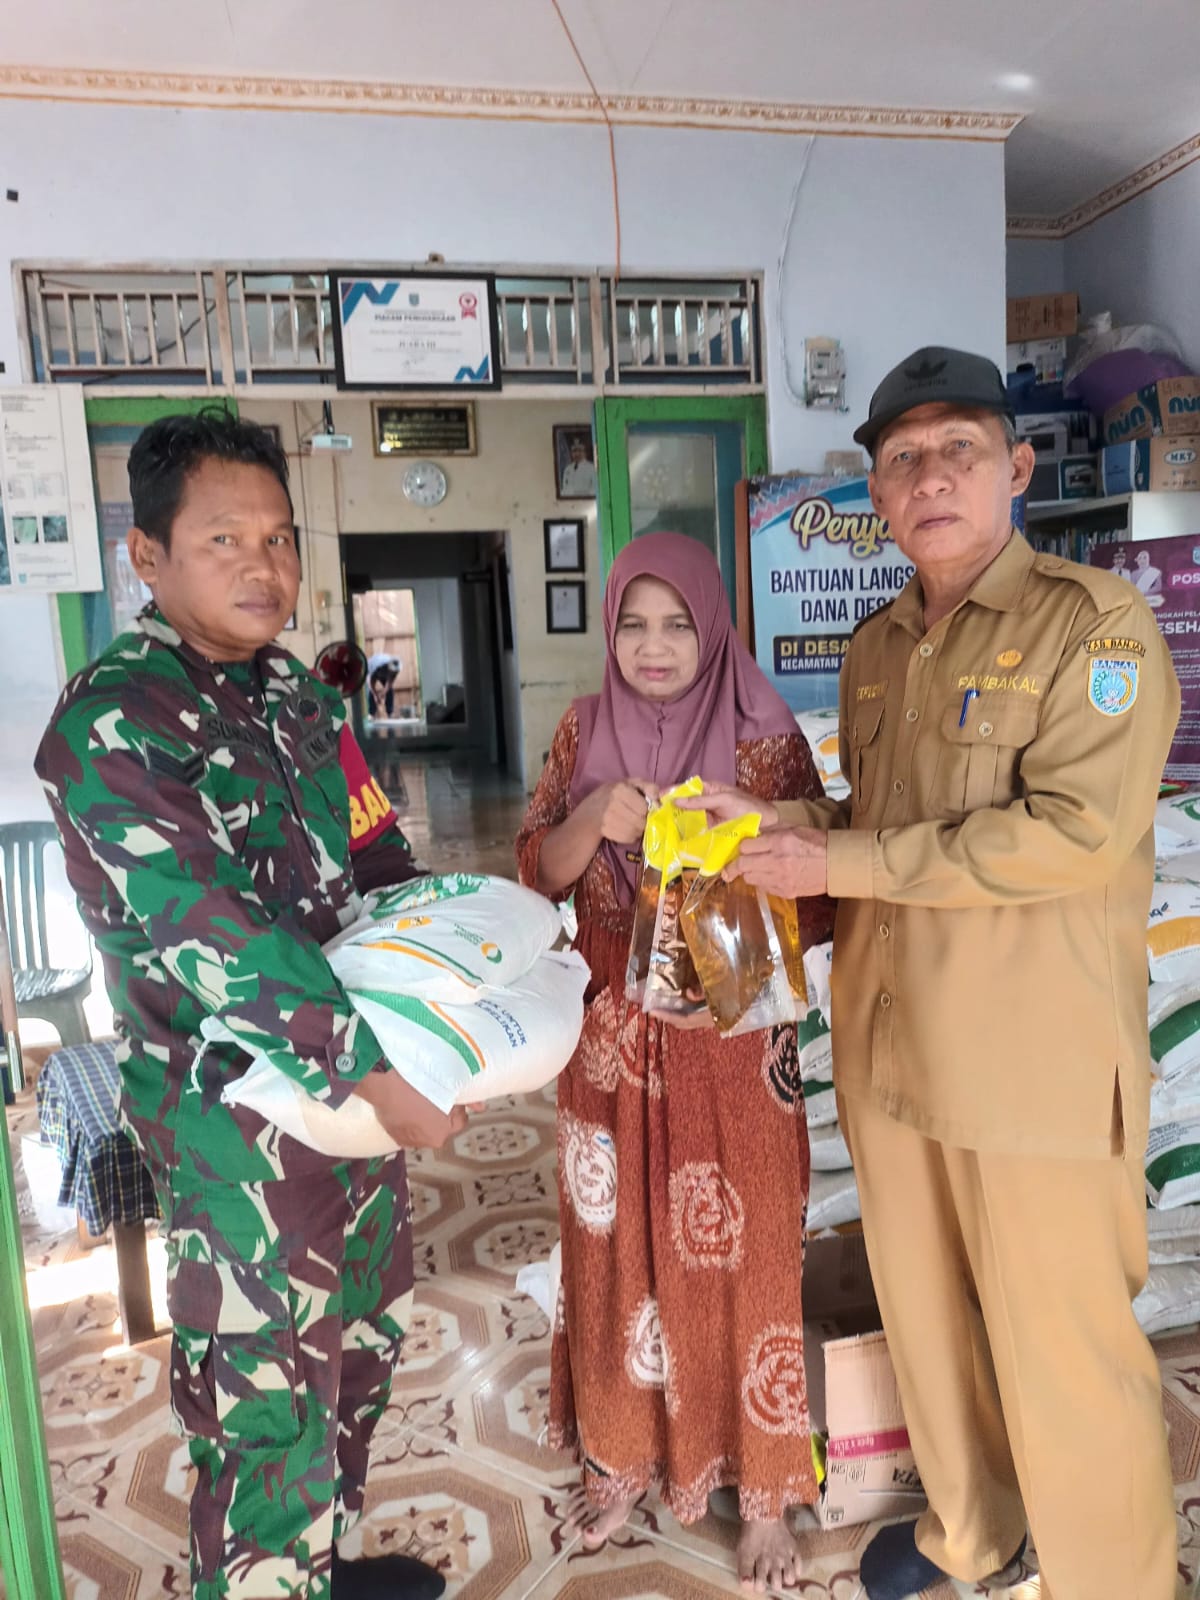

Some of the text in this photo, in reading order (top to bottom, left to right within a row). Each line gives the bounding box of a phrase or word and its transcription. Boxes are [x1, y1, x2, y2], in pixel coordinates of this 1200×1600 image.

[771, 568, 854, 594] BANTUAN
[800, 598, 848, 623] DANA
[780, 639, 850, 657] DI DESA
[780, 657, 838, 671] KECAMATAN
[1092, 659, 1138, 671] BANJAR
[957, 675, 1042, 696] PAMBAKAL
